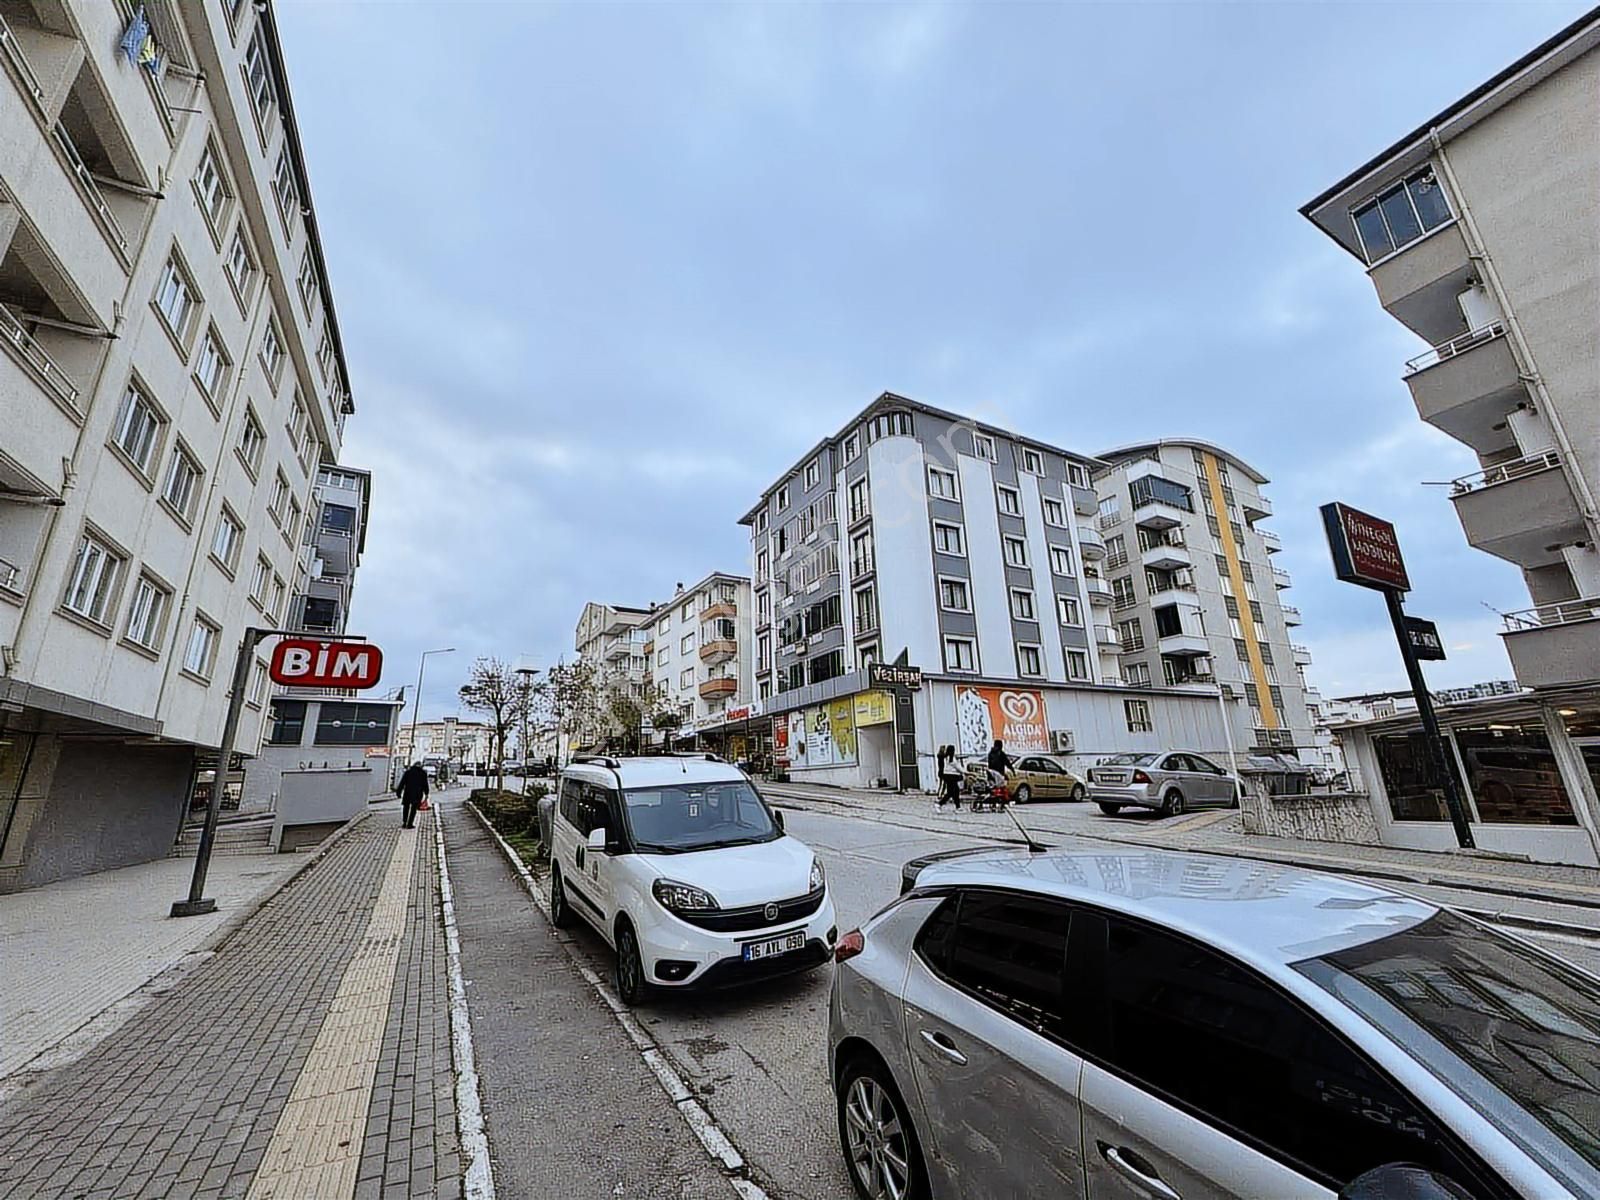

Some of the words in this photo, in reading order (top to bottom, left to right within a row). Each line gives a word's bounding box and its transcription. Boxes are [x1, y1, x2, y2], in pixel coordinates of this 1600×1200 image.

[281, 643, 368, 679] BİM
[1003, 723, 1043, 738] ALGIDA
[751, 945, 761, 958] 16
